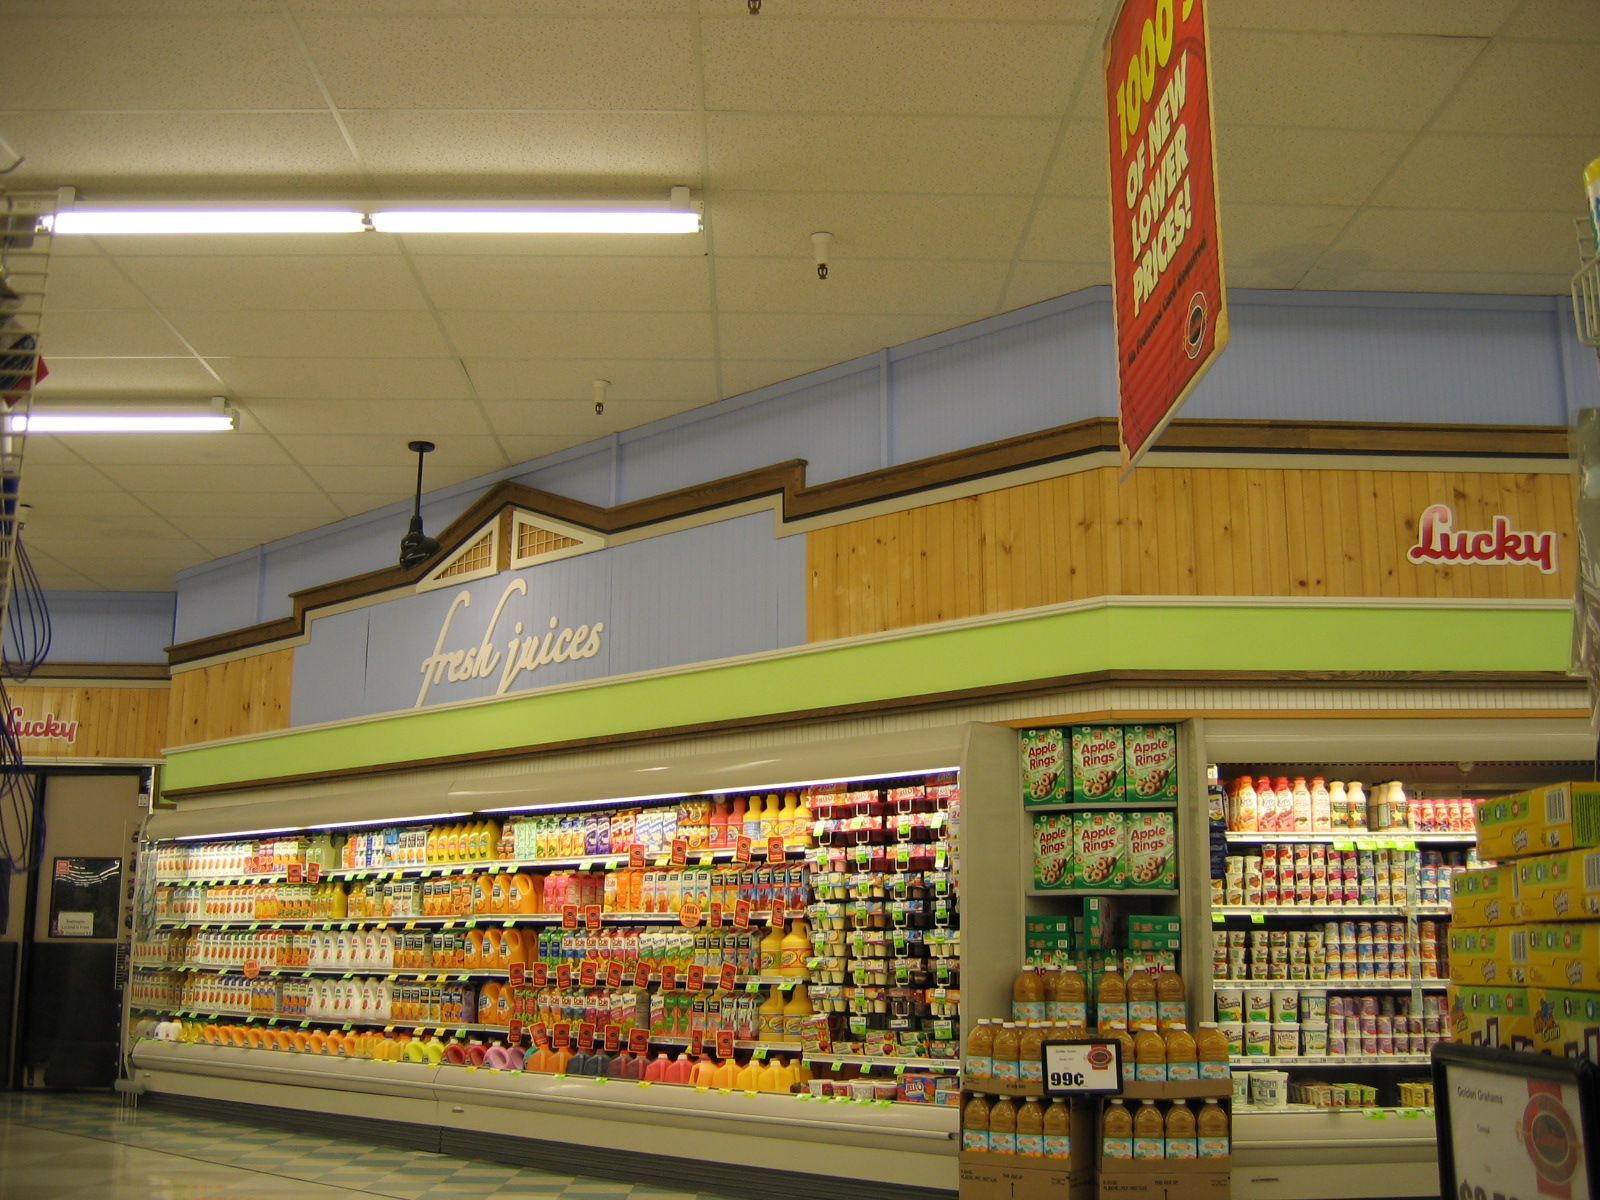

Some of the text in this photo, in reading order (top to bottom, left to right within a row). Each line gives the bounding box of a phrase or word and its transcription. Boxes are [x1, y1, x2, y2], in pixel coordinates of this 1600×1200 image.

[1116, 0, 1194, 159] 1000
[1126, 49, 1187, 209] OF NEW
[1131, 123, 1190, 262] LOWER
[1133, 174, 1192, 318] PRICES!
[1408, 504, 1555, 573] Lucky
[415, 578, 605, 708] fresh juices
[6, 706, 78, 743] Lucky
[1028, 742, 1056, 758] Apple
[1081, 739, 1116, 755] Apple
[1133, 739, 1168, 754] Apple
[1029, 755, 1056, 770] Rings
[1083, 752, 1115, 767] Rings
[1135, 751, 1167, 767] Rings
[1039, 828, 1066, 844] Apple
[1081, 825, 1116, 841] Apple
[1131, 825, 1166, 841] Apple
[1040, 840, 1065, 855] Rings
[1083, 838, 1115, 853] Rings
[1132, 838, 1164, 853] Rings
[1051, 1072, 1084, 1087] 99¢
[1457, 1086, 1503, 1104] Golden Grahams
